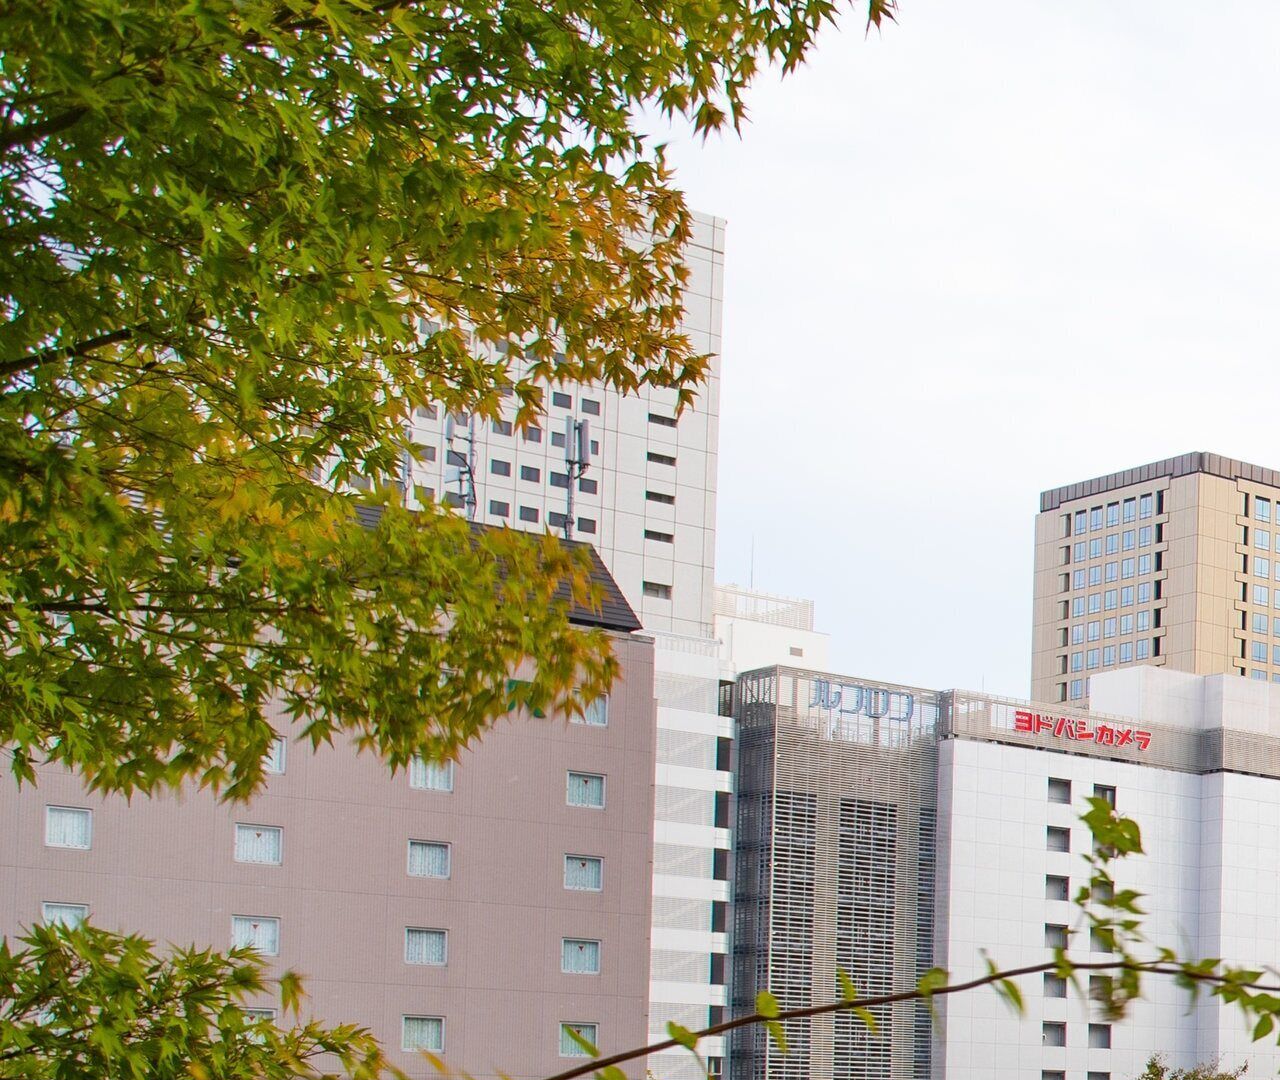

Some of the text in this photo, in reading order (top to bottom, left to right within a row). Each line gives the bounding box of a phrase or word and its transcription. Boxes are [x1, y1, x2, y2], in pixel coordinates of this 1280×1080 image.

[1014, 710, 1153, 751] ヨドバシカメラ
